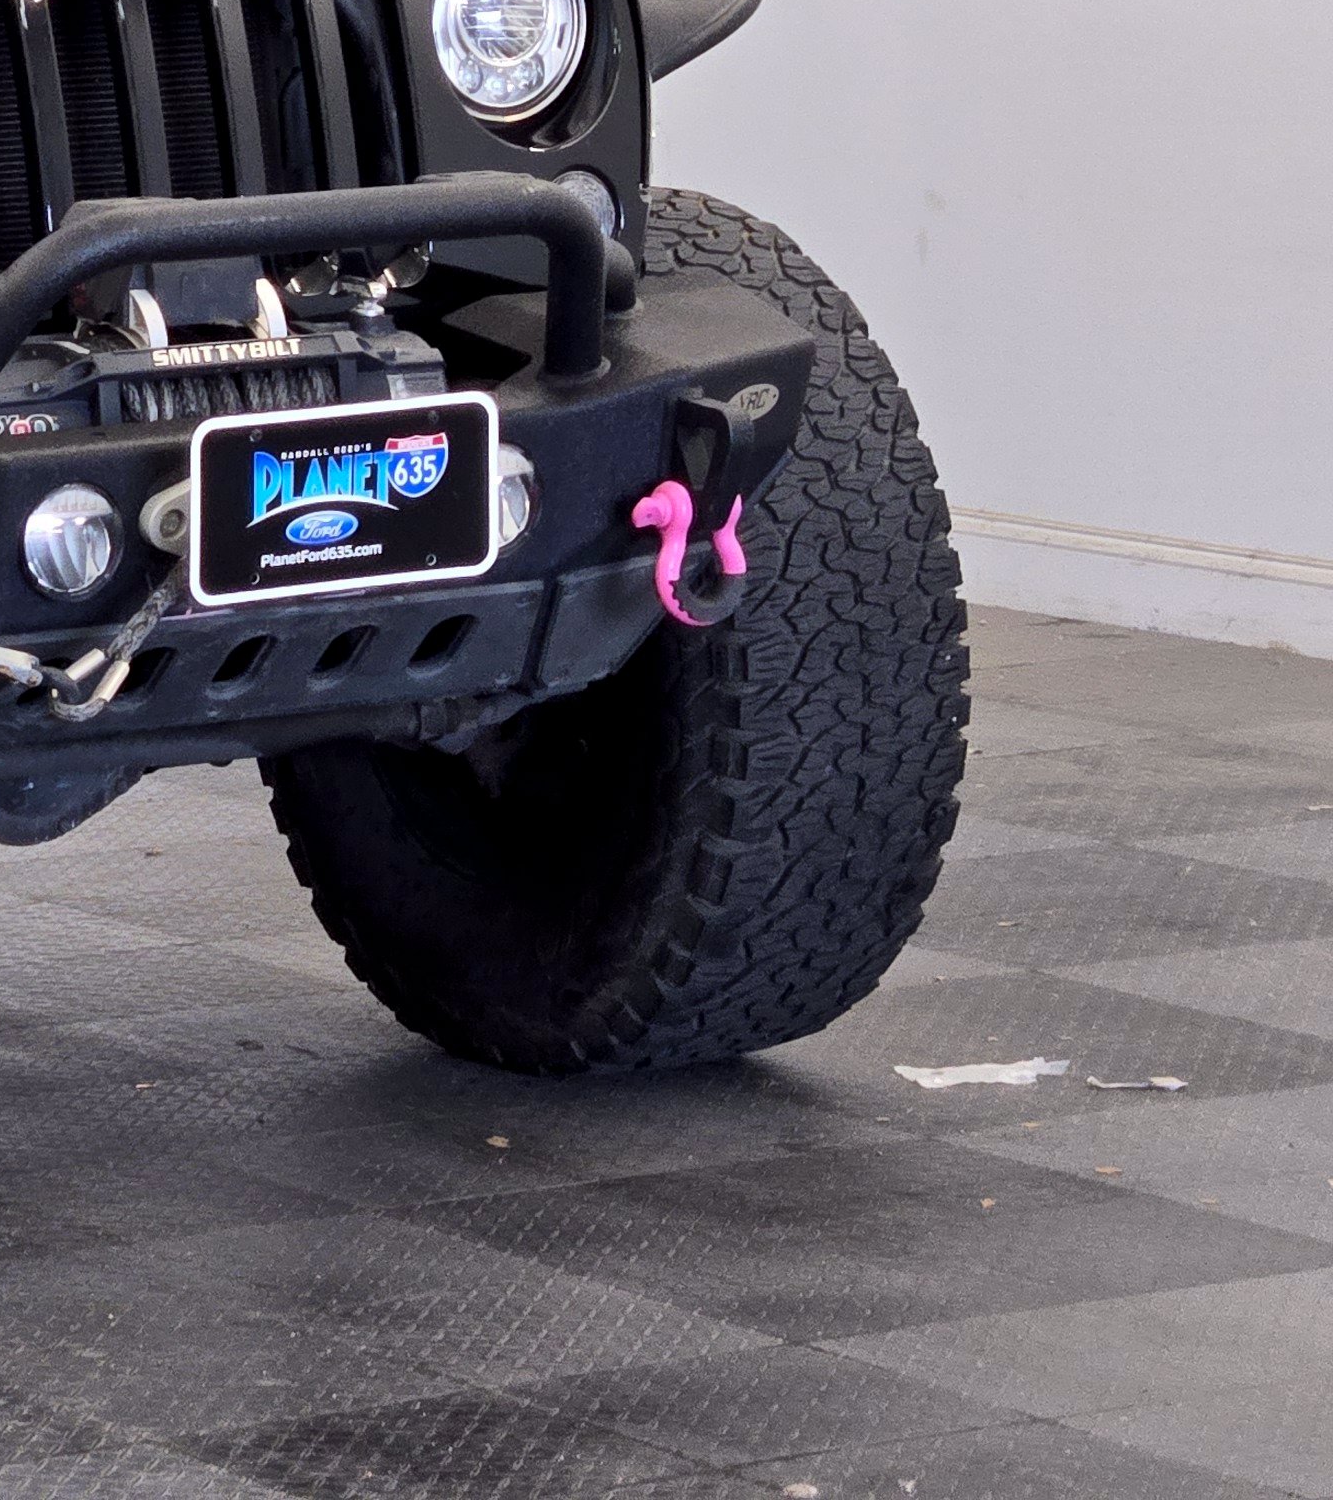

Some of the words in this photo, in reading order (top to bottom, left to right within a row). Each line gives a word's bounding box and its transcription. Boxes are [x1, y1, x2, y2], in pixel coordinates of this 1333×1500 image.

[152, 338, 302, 367] SMITTYBILT
[393, 454, 437, 486] 635
[254, 450, 394, 520] PLANET
[298, 516, 344, 540] Ford
[259, 543, 383, 569] PlanetFord635.com
